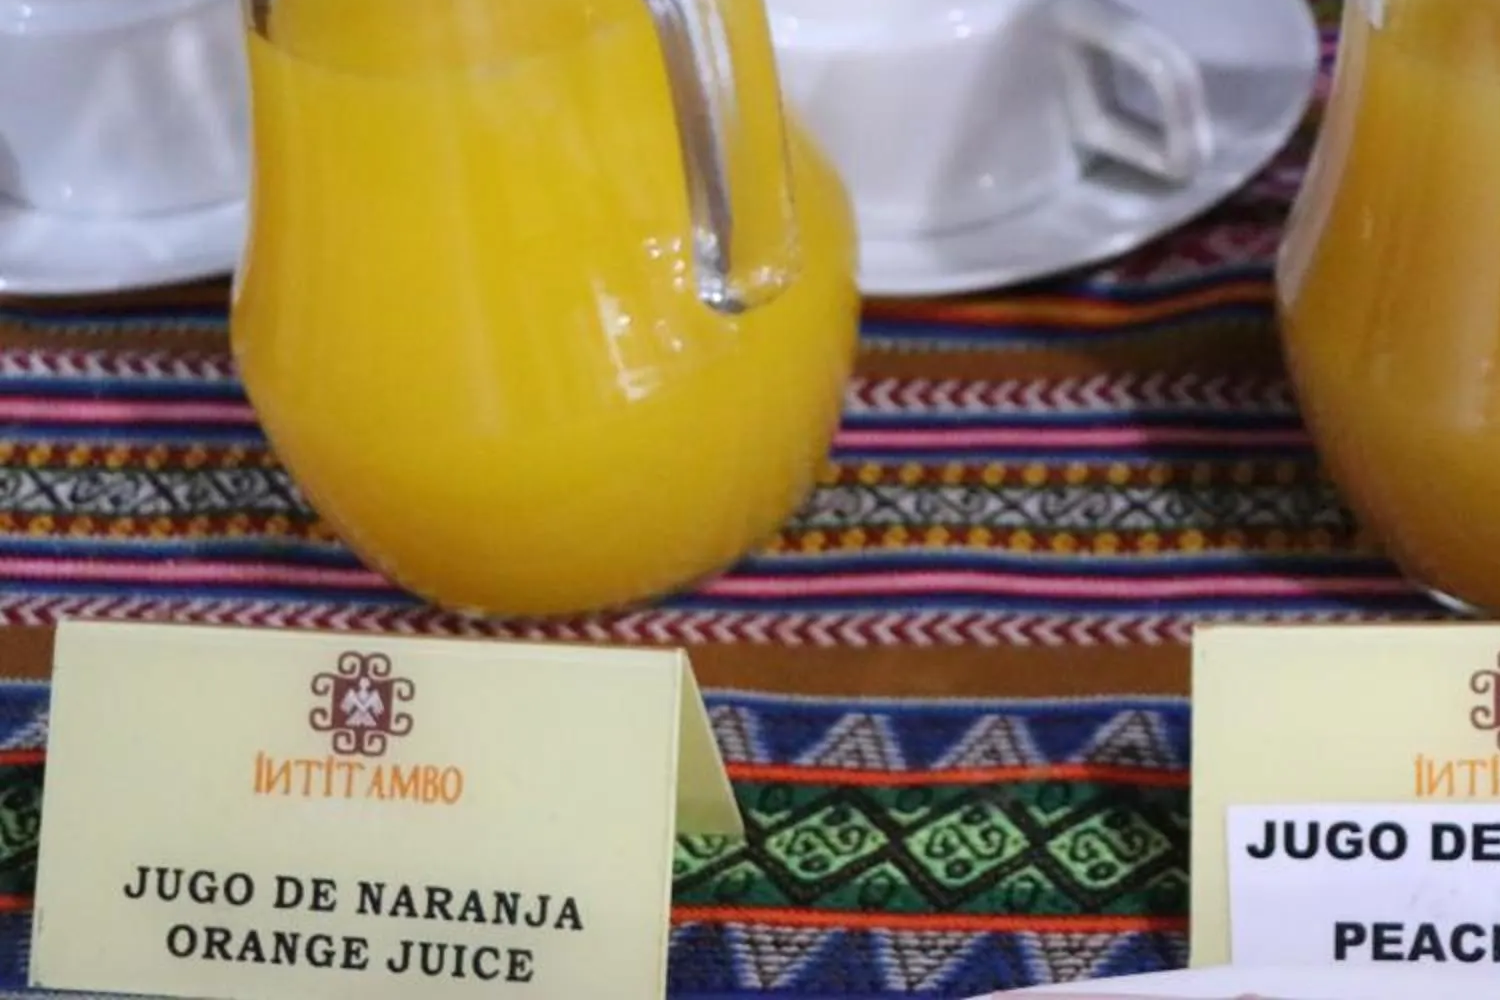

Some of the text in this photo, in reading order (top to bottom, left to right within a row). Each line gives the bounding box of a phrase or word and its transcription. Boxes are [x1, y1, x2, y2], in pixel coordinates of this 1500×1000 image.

[1245, 820, 1408, 862] JUGO
[123, 866, 585, 932] JUGO DE NARANJA
[166, 924, 534, 983] ORANGE JUICE
